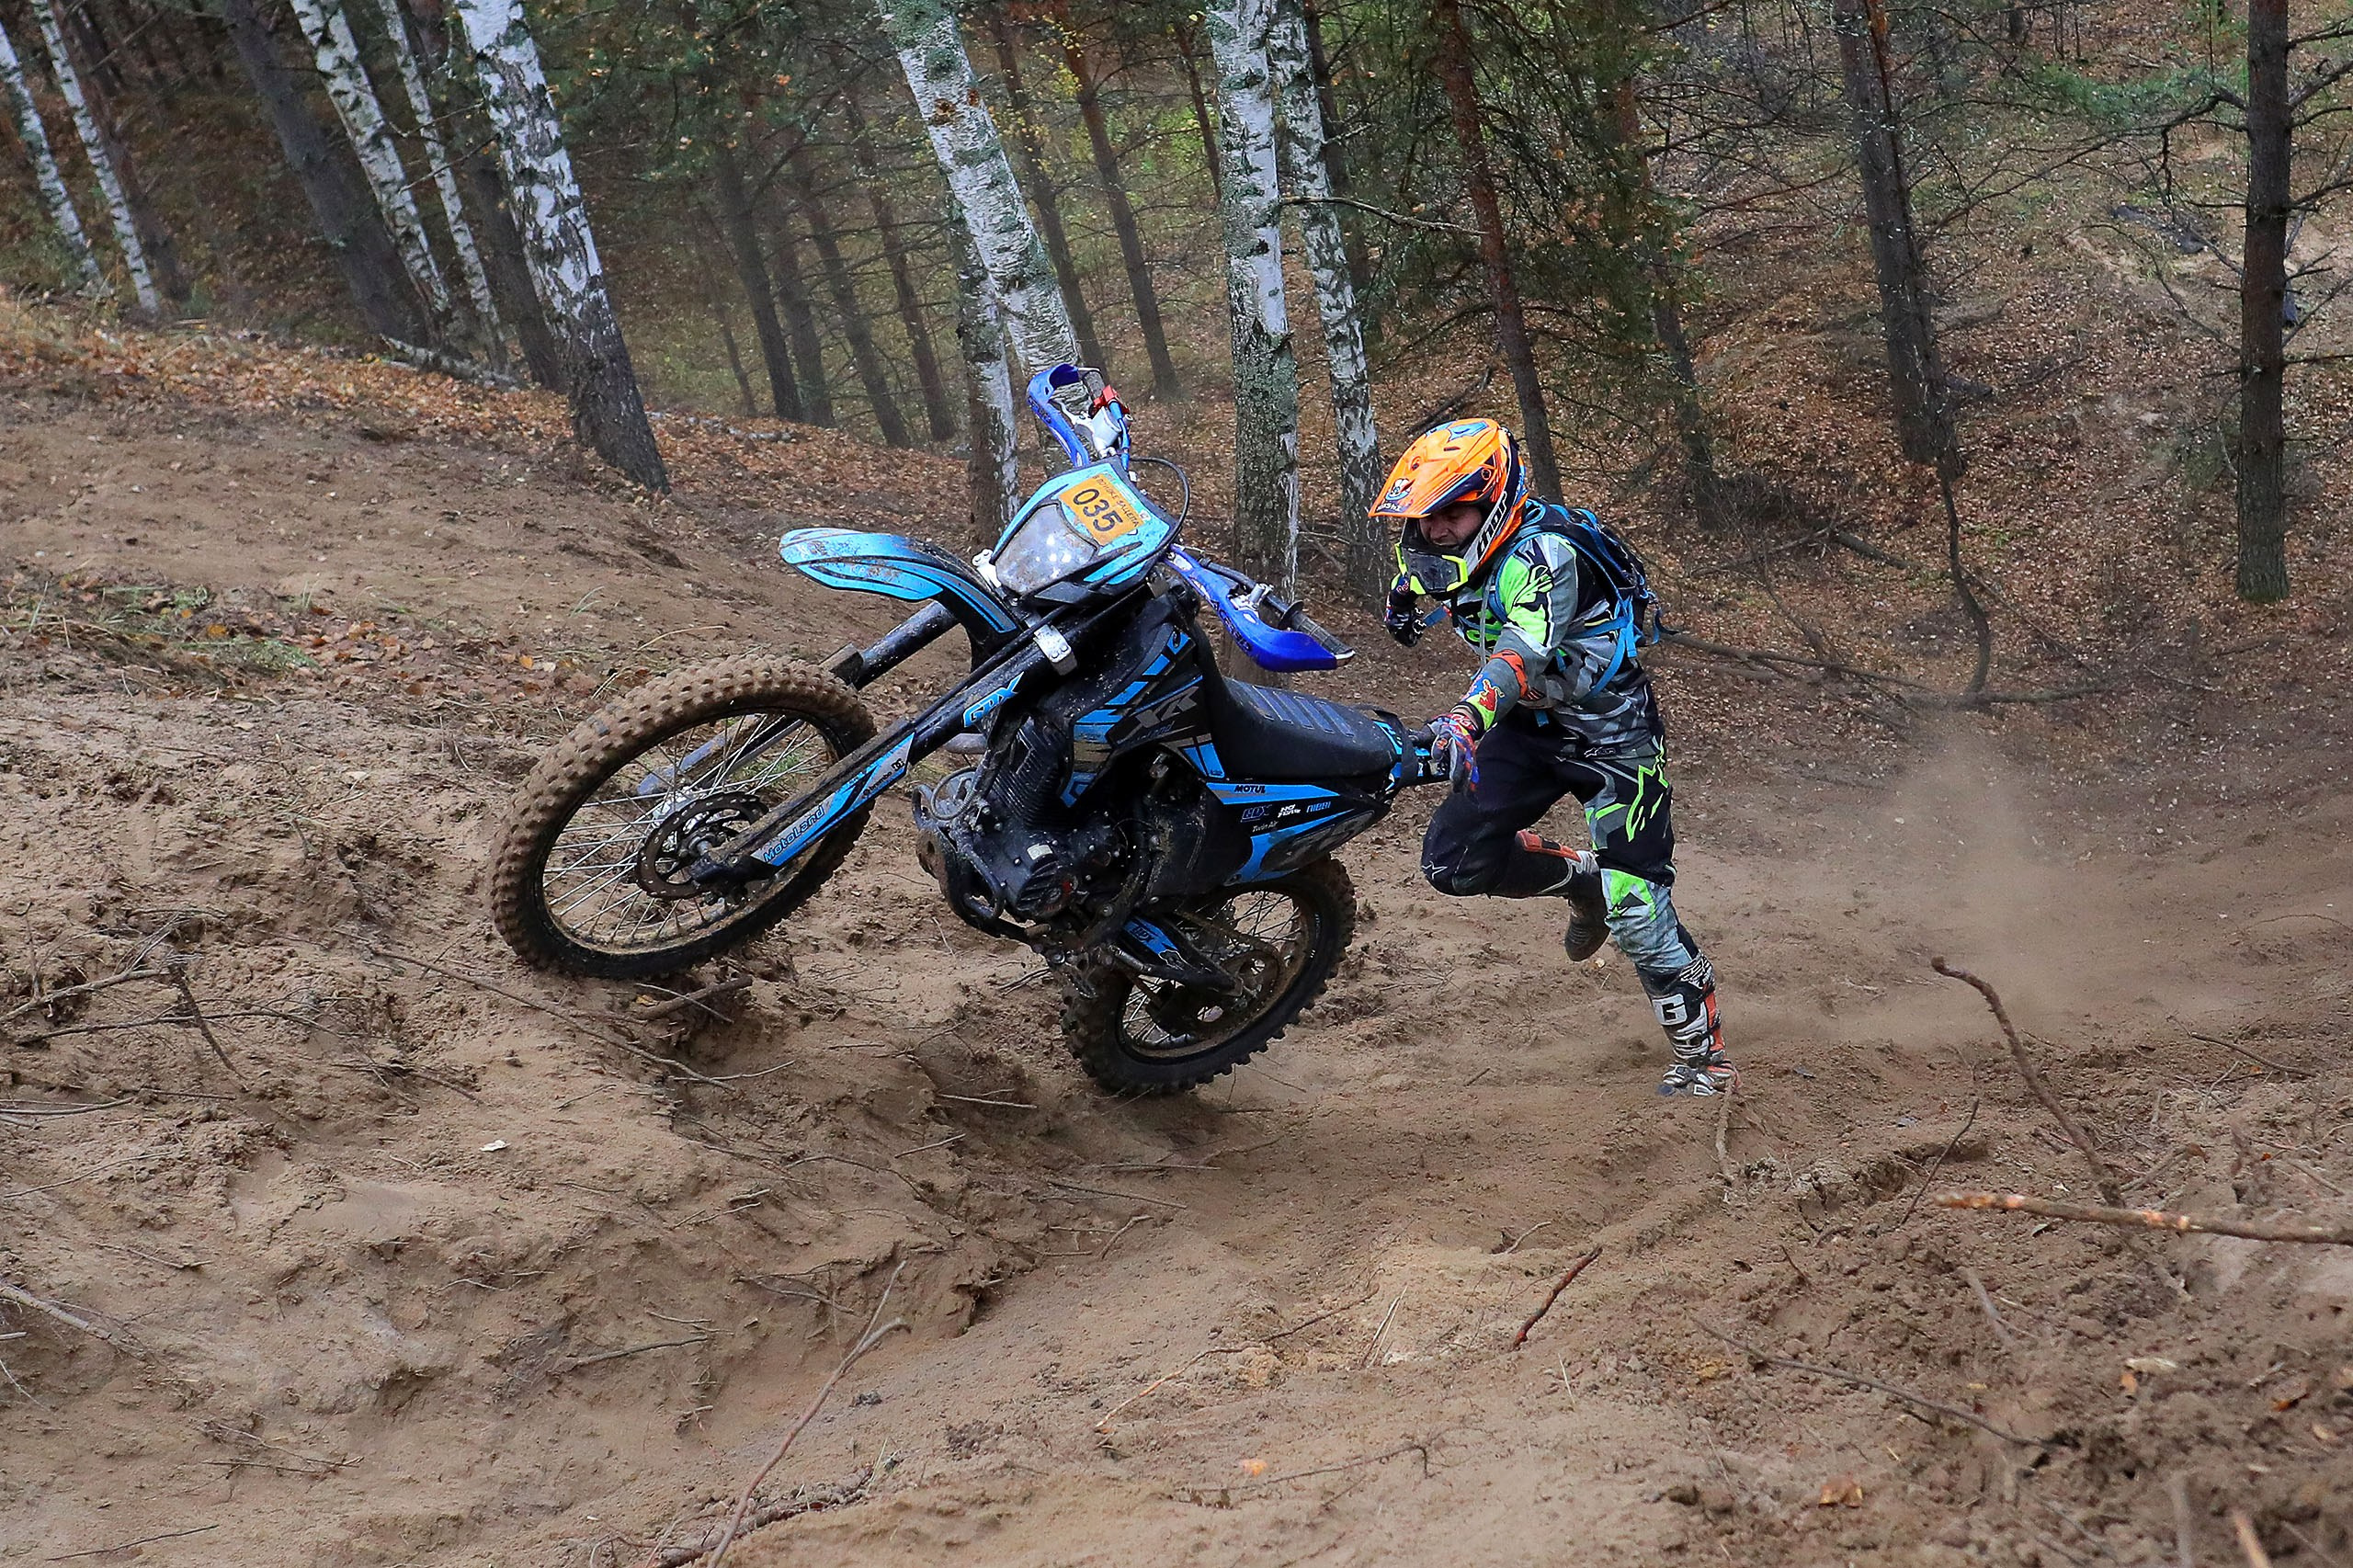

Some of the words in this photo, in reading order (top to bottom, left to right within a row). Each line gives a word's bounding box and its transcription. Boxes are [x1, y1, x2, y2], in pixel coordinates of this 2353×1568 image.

[1073, 488, 1123, 532] 035
[1477, 490, 1508, 561] thor
[869, 771, 892, 791] brembo
[1233, 784, 1267, 794] MOTUL
[763, 804, 825, 862] MotoLand
